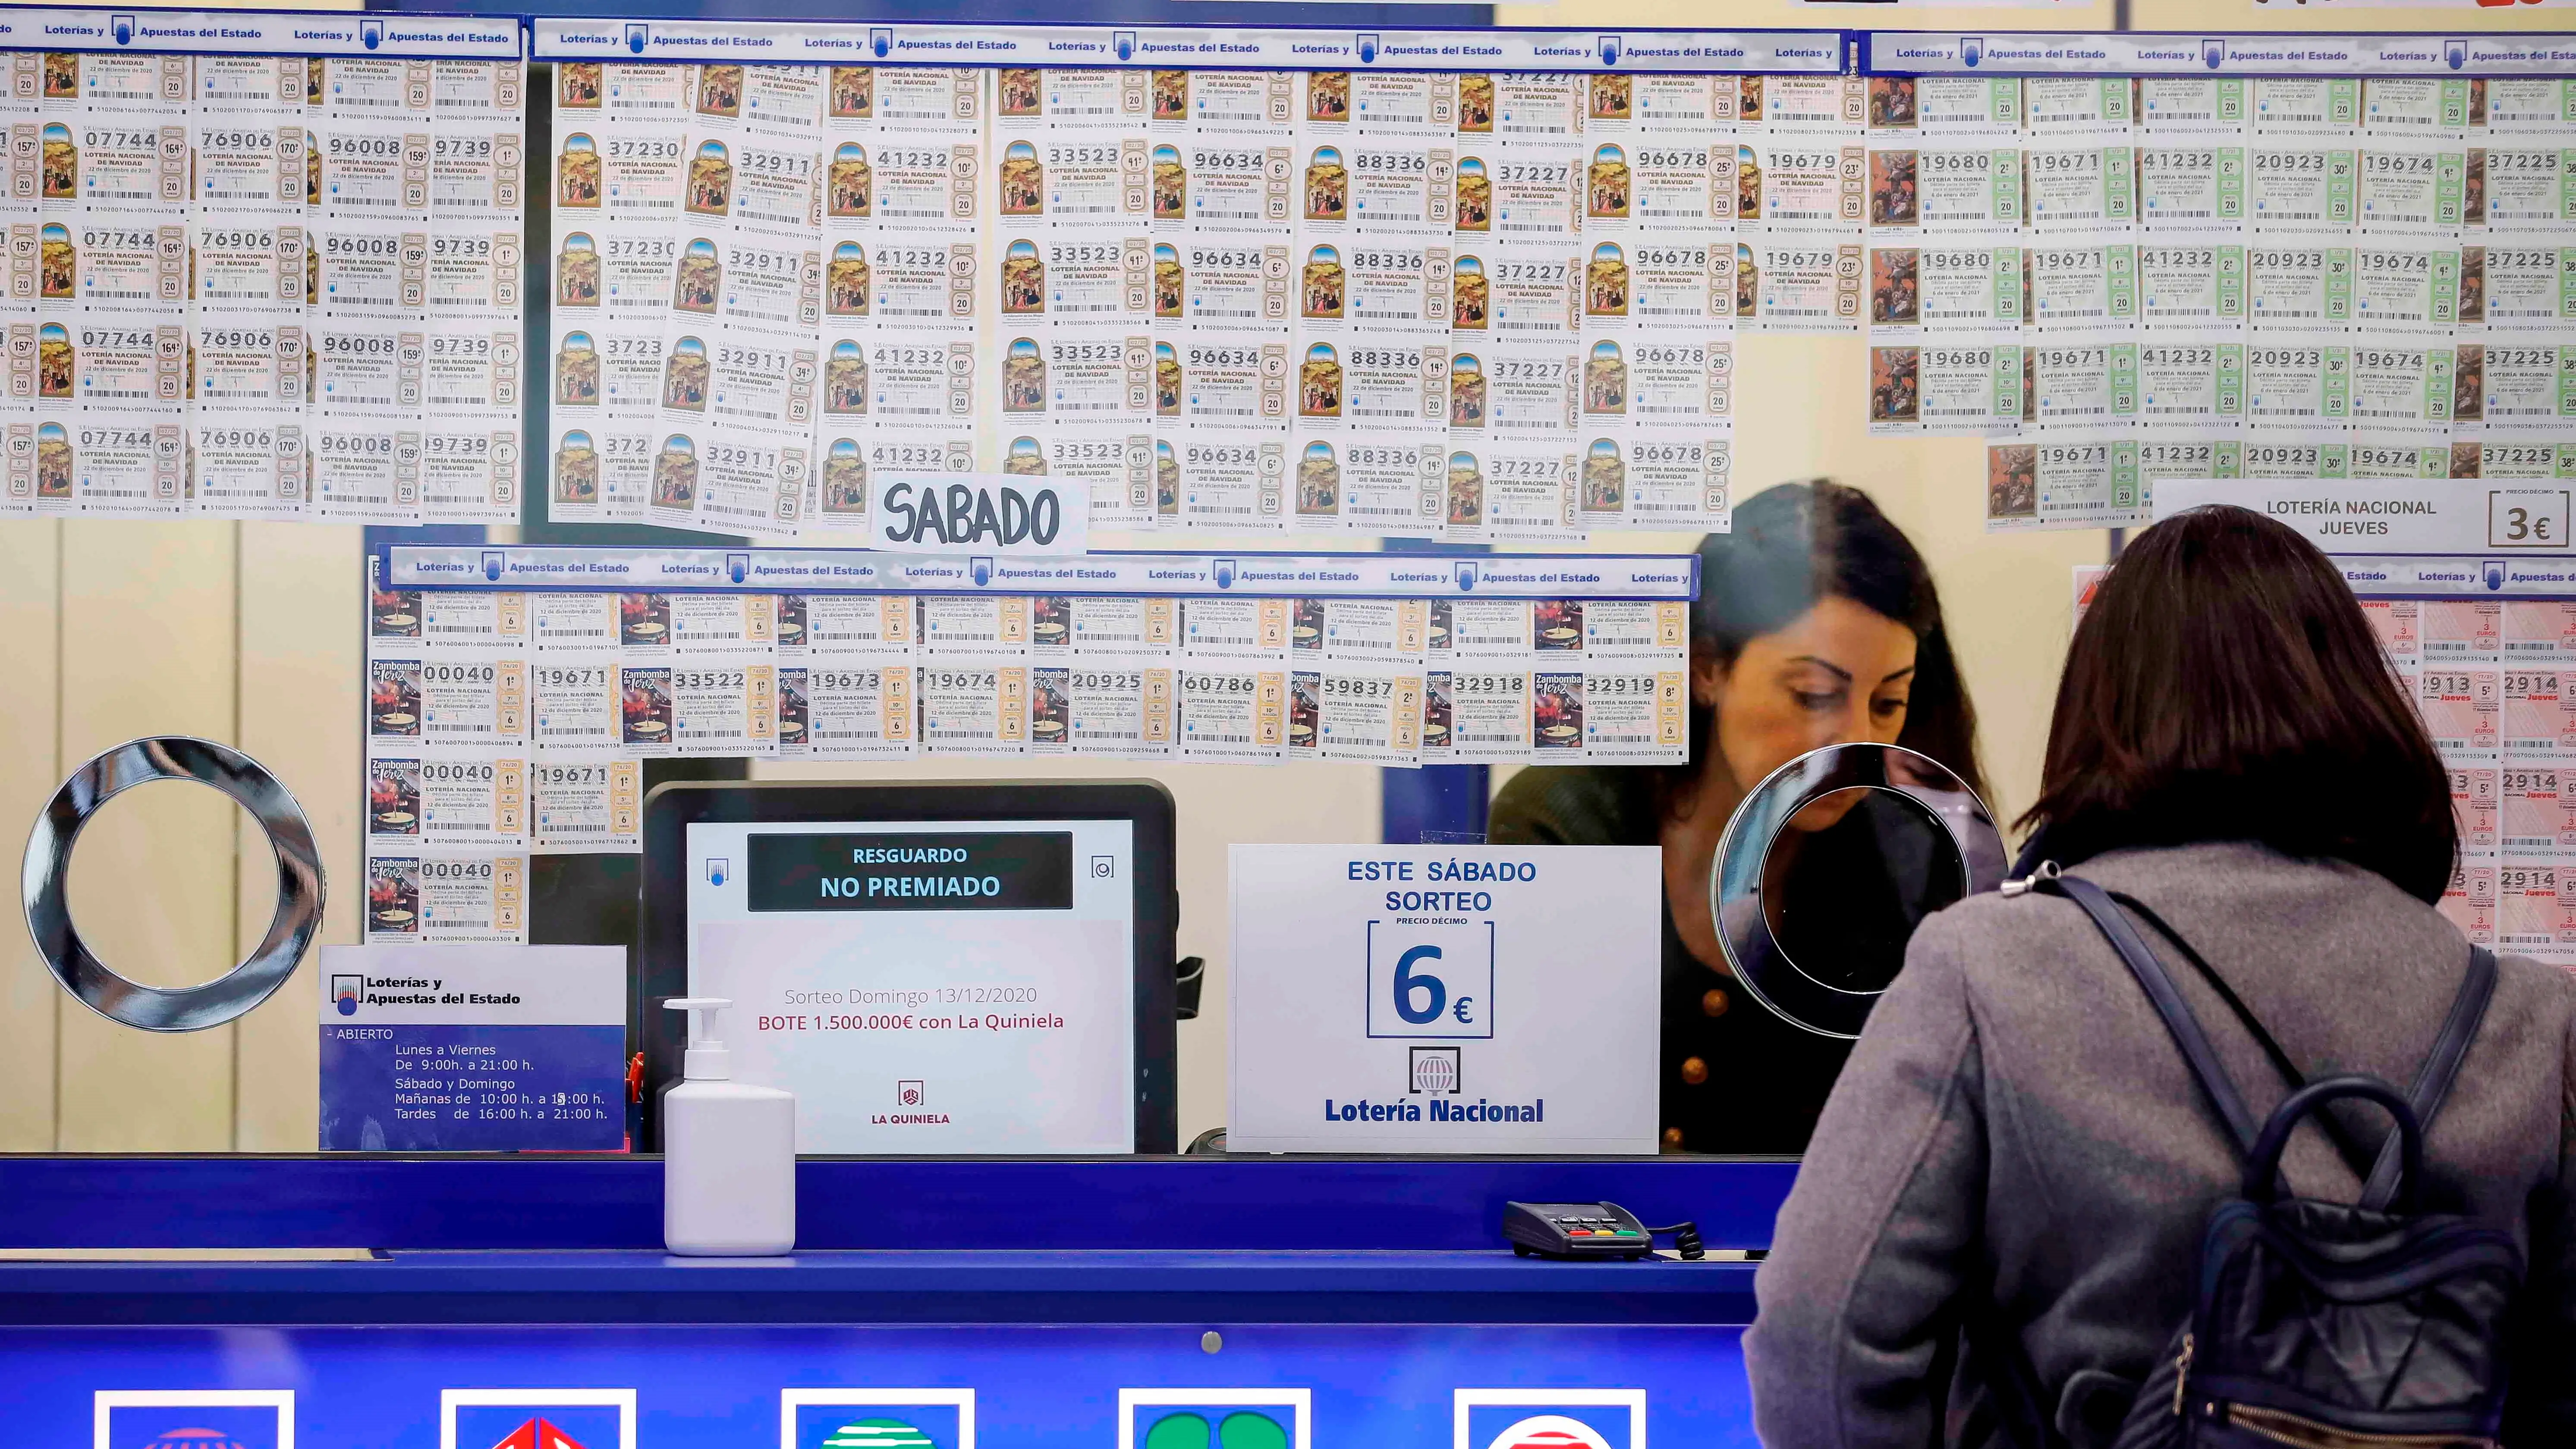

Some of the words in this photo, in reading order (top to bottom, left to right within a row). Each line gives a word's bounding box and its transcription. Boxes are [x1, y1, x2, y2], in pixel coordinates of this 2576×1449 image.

[45, 25, 94, 35] Loterías
[97, 28, 104, 37] y
[140, 27, 196, 38] Apuestas
[199, 28, 217, 37] del
[221, 29, 261, 38] Estado
[560, 34, 608, 44] Loterías
[611, 37, 618, 45] y
[653, 36, 708, 46] Apuestas
[711, 37, 729, 45] del
[733, 37, 773, 46] Estado
[1534, 47, 1581, 56] Loterías
[1585, 49, 1592, 58] y
[1626, 47, 1680, 58] Apuestas
[1683, 48, 1700, 57] del
[1705, 48, 1744, 57] Estado
[1897, 49, 1943, 58] Loterías
[1947, 51, 1953, 60] y
[1988, 49, 2041, 60] Apuestas
[2045, 50, 2063, 58] del
[2066, 50, 2106, 59] Estado
[86, 132, 156, 147] 07744
[203, 133, 272, 147] 76906
[609, 142, 678, 157] 37230
[878, 151, 947, 167] 41232
[1639, 152, 1707, 166] 96678
[2033, 155, 2098, 170] 19671
[2144, 153, 2213, 167] 41232
[2366, 156, 2434, 171] 19674
[1500, 167, 1568, 181] 37227
[167, 182, 177, 191] 20
[1354, 254, 1422, 268] 88336
[1768, 252, 1833, 266] 19679
[83, 332, 153, 346] 07744
[324, 338, 394, 352] 96008
[719, 348, 786, 370] 32911
[1053, 346, 1122, 359] 33523
[1924, 352, 1990, 365] 19680
[2252, 351, 2320, 365] 20923
[2487, 352, 2554, 364] 37225
[1188, 448, 1256, 462] 96634
[2267, 498, 2341, 515] LOTERÍA
[2346, 501, 2437, 514] NACIONAL
[884, 483, 1060, 547] SABADO
[2319, 522, 2388, 535] JUEVES
[416, 563, 464, 571] Loterías
[468, 565, 474, 573] y
[510, 563, 564, 573] Apuestas
[568, 563, 585, 572] del
[589, 563, 629, 573] Estado
[1390, 572, 1438, 581] Loterías
[1441, 575, 1448, 584] y
[1482, 573, 1536, 584] Apuestas
[1540, 574, 1557, 582] del
[1560, 574, 1600, 582] Estado
[2347, 571, 2387, 581] Estado
[2419, 572, 2466, 581] Loterías
[2469, 575, 2475, 583] y
[2510, 572, 2565, 583] Apuestas
[424, 667, 494, 681] 00040
[539, 671, 605, 683] 19671
[624, 670, 670, 679] Zambomba
[676, 673, 743, 687] 33522
[813, 673, 879, 688] 19673
[928, 673, 996, 688] 19674
[1072, 674, 1140, 688] 20925
[1185, 677, 1255, 691] 60786
[1324, 679, 1392, 695] 59837
[1455, 677, 1522, 691] 32918
[1587, 679, 1654, 692] 32919
[541, 769, 606, 782] 19671
[853, 848, 967, 863] RESGUARDO
[422, 864, 491, 877] 00040
[1348, 861, 1413, 881] ESTE
[1428, 858, 1536, 882] SÁBADO
[821, 877, 859, 897] NO
[868, 876, 1000, 897] PREMIADO
[1386, 891, 1491, 912] SORTEO
[1431, 916, 1468, 924] DÉCIMO
[367, 977, 428, 988] Loterías
[433, 980, 442, 990] y
[367, 993, 436, 1006] Apuestas
[441, 993, 464, 1004] del
[469, 993, 520, 1004] Estado
[785, 990, 843, 1004] Sorteo
[850, 989, 928, 1008] Domingo
[936, 988, 1037, 1003] 13/12/2020
[759, 1016, 807, 1030] BOTE
[814, 1015, 913, 1030] 1.500.000€
[919, 1018, 951, 1029] con
[959, 1015, 978, 1028] La
[985, 1013, 1063, 1031] Quiniela
[337, 1029, 393, 1040] ABIERTO
[396, 1044, 432, 1055] Lunes
[437, 1047, 444, 1055] a
[449, 1044, 496, 1055] Viernes
[396, 1059, 412, 1070] De
[421, 1059, 463, 1070] 9:00h.
[468, 1062, 475, 1070] a
[480, 1059, 518, 1070] 21:00
[522, 1059, 534, 1070] h.
[395, 1077, 442, 1089] Sábado
[447, 1081, 454, 1091] y
[459, 1078, 515, 1091] Domingo
[396, 1093, 451, 1104] Mañanas
[455, 1093, 471, 1104] de
[481, 1093, 517, 1104] 10:00
[522, 1093, 533, 1104] h.
[538, 1096, 546, 1104] a
[593, 1093, 604, 1104] h.
[394, 1108, 436, 1119] Tardes
[454, 1108, 469, 1119] de
[479, 1108, 516, 1119] 16:00
[521, 1108, 532, 1119] h.
[537, 1111, 544, 1119] a
[554, 1109, 591, 1119] 21:00
[596, 1108, 607, 1119] h.
[1326, 1098, 1421, 1122] Lotería
[1430, 1098, 1543, 1122] Nacional
[872, 1115, 887, 1124] LA
[890, 1114, 950, 1124] QUINIELA
